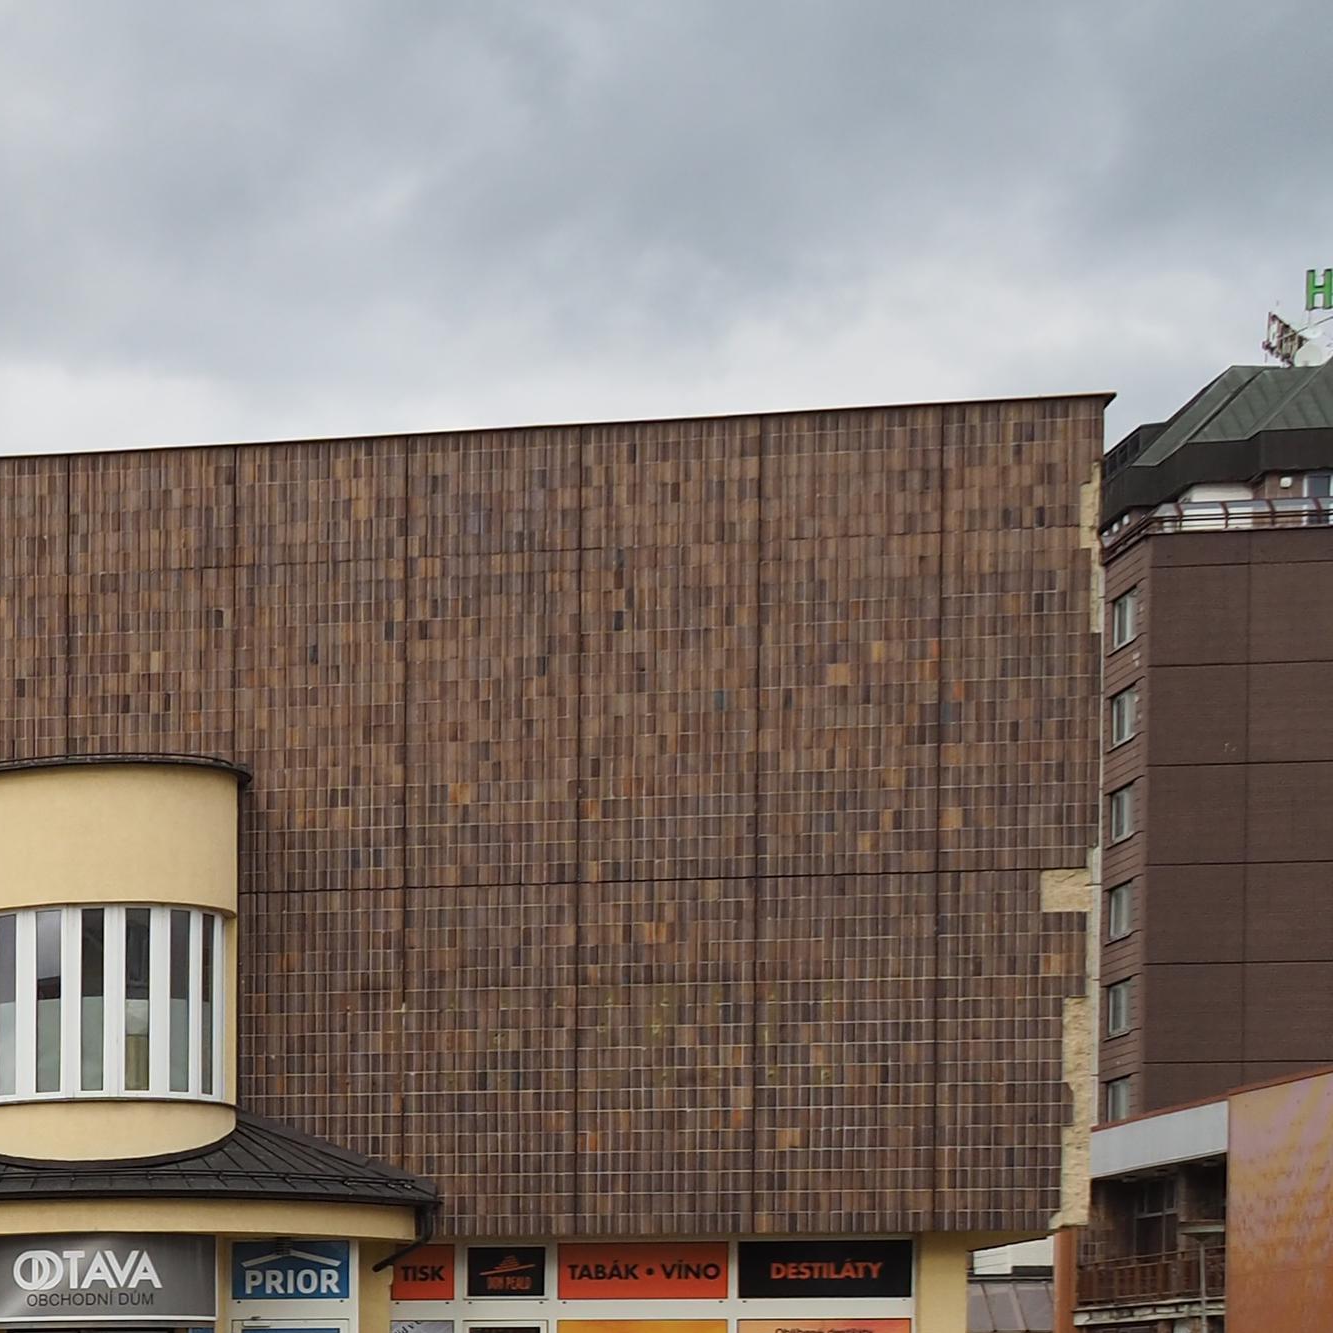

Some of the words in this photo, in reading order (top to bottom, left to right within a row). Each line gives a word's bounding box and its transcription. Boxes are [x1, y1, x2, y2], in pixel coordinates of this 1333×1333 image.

[401, 1264, 446, 1282] TISK
[567, 1259, 640, 1280] TABÁK
[660, 1258, 721, 1280] VÍNO
[770, 1257, 883, 1280] DESTILÁTY
[245, 1268, 341, 1295] PRIOR
[26, 1289, 114, 1308] OBCHODNÍ
[118, 1290, 155, 1307] DŮM
